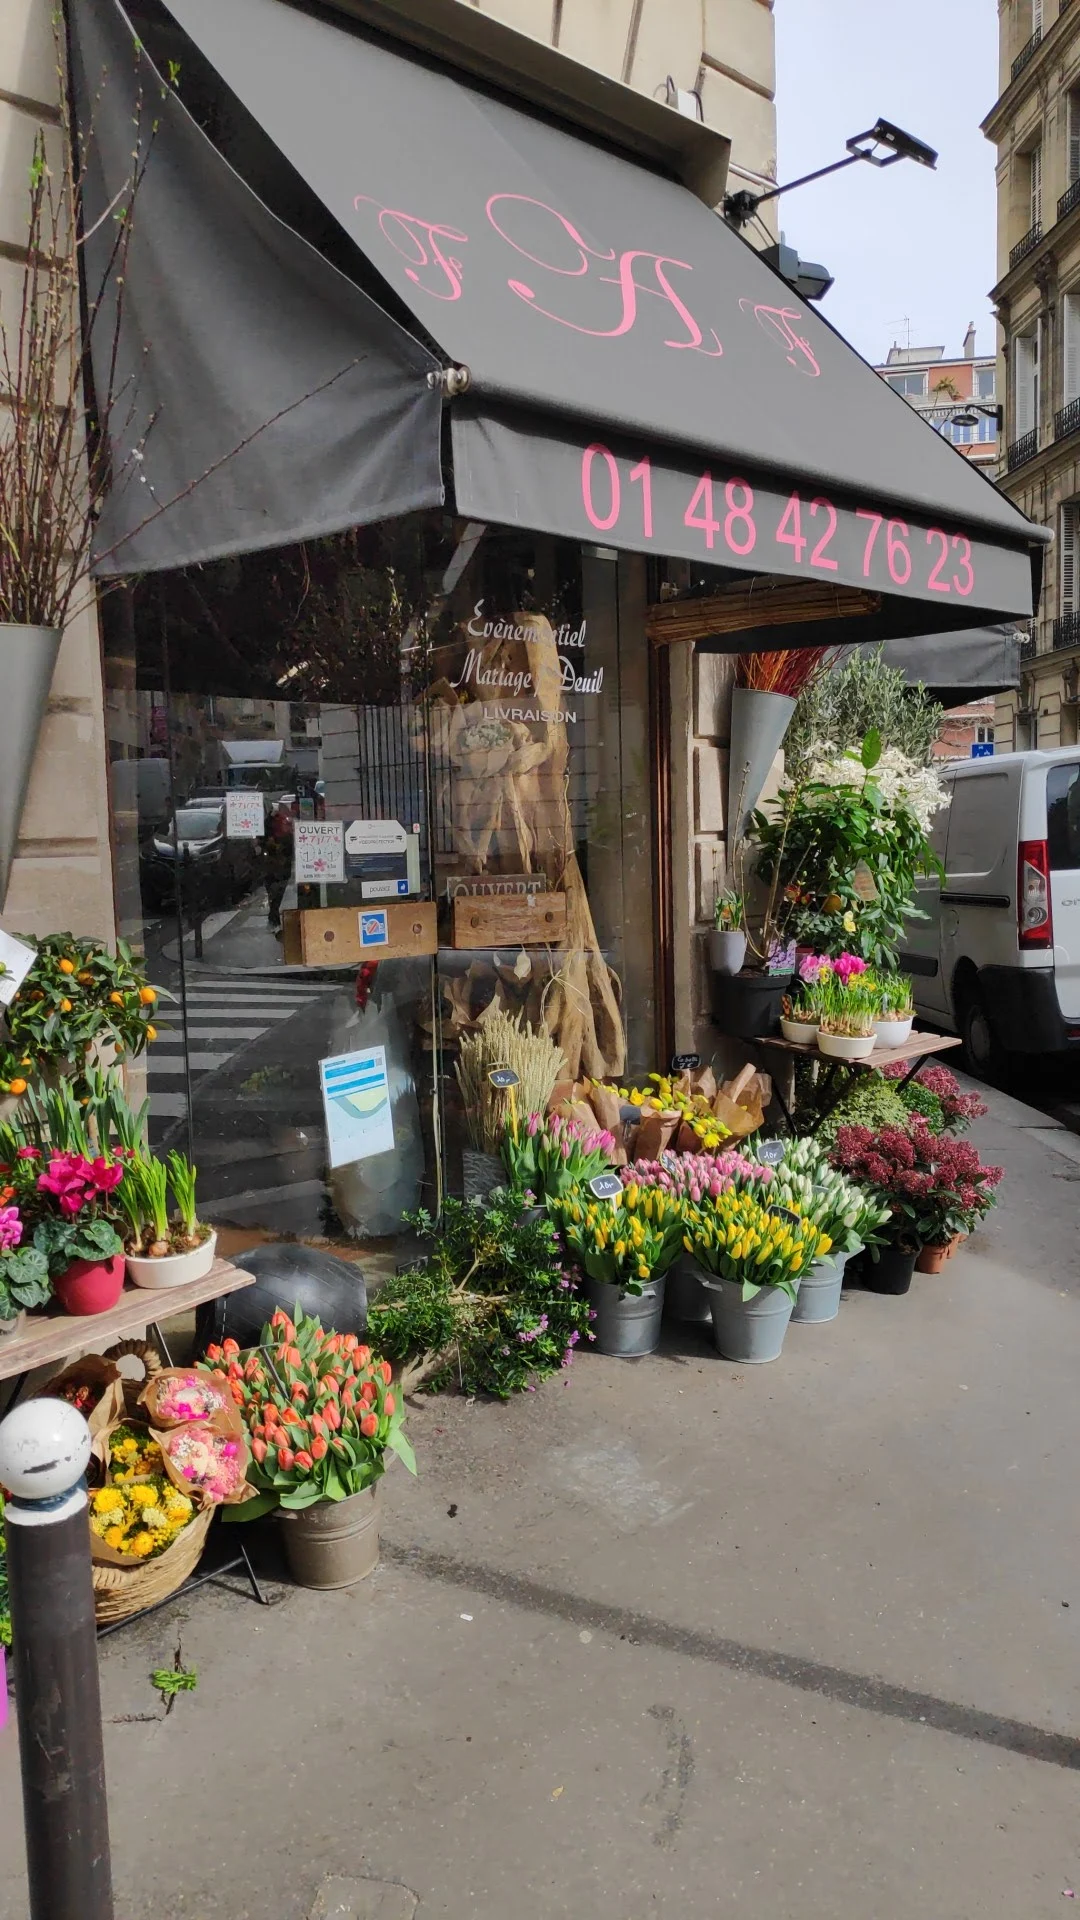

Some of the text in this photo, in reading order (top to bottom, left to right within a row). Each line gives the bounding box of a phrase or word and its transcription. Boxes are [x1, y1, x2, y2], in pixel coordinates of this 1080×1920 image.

[581, 442, 975, 597] 01 48 42 76 23
[467, 598, 587, 648] Evènemntiel
[450, 648, 532, 697] Mariage
[549, 655, 604, 694] Deuil
[484, 707, 577, 723] LIVRAISON
[299, 826, 340, 834] OUVERT
